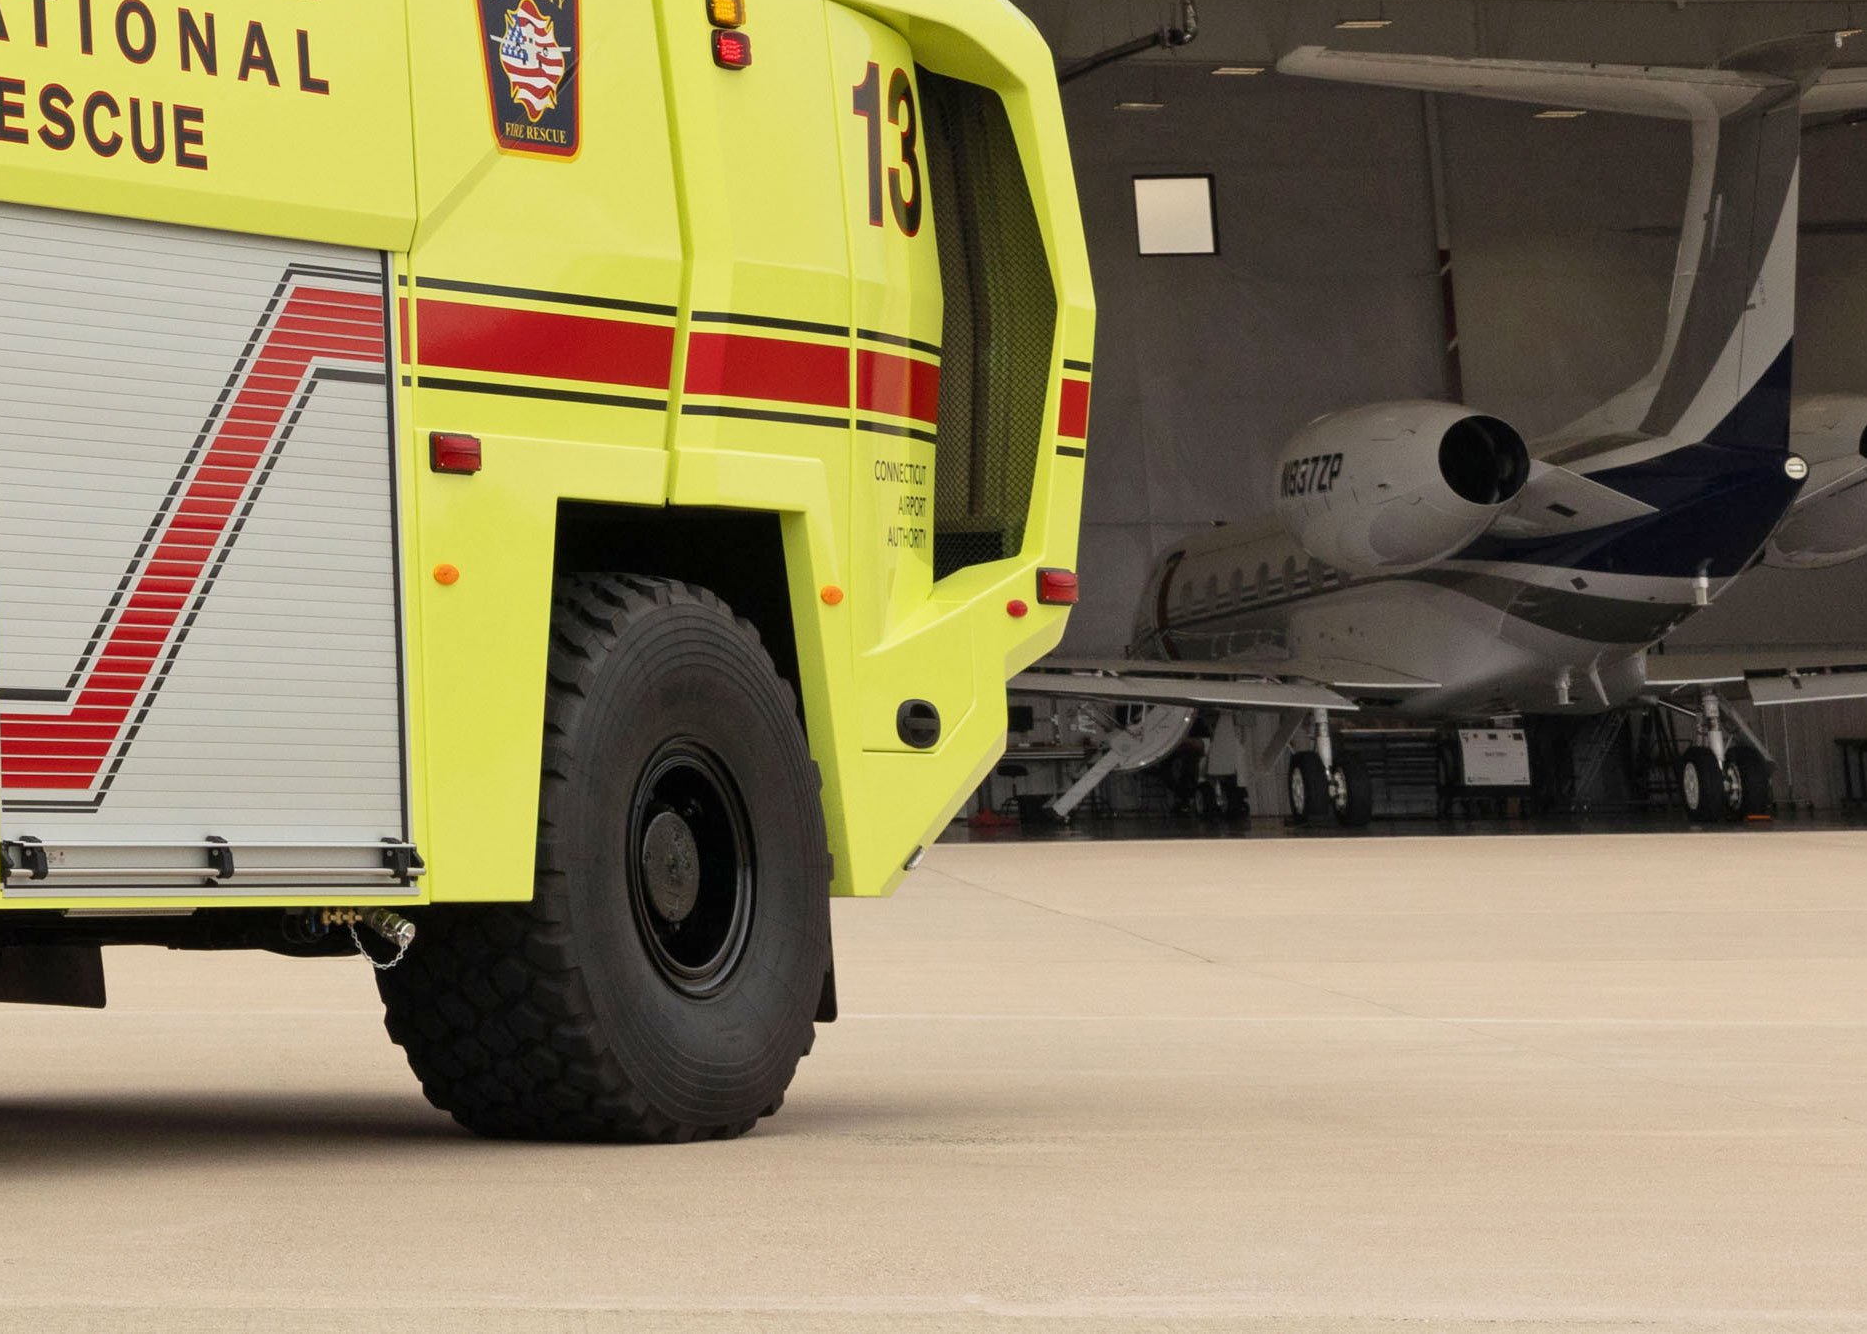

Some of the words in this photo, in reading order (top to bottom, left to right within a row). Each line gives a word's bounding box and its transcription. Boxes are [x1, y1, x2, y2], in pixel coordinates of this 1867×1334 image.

[505, 122, 525, 139] FIRE
[527, 125, 568, 145] RESCUE
[851, 60, 922, 239] 13
[874, 459, 927, 485] CONNECTICUT
[898, 495, 927, 516] AIRPORT
[887, 526, 927, 548] AUTHORITY
